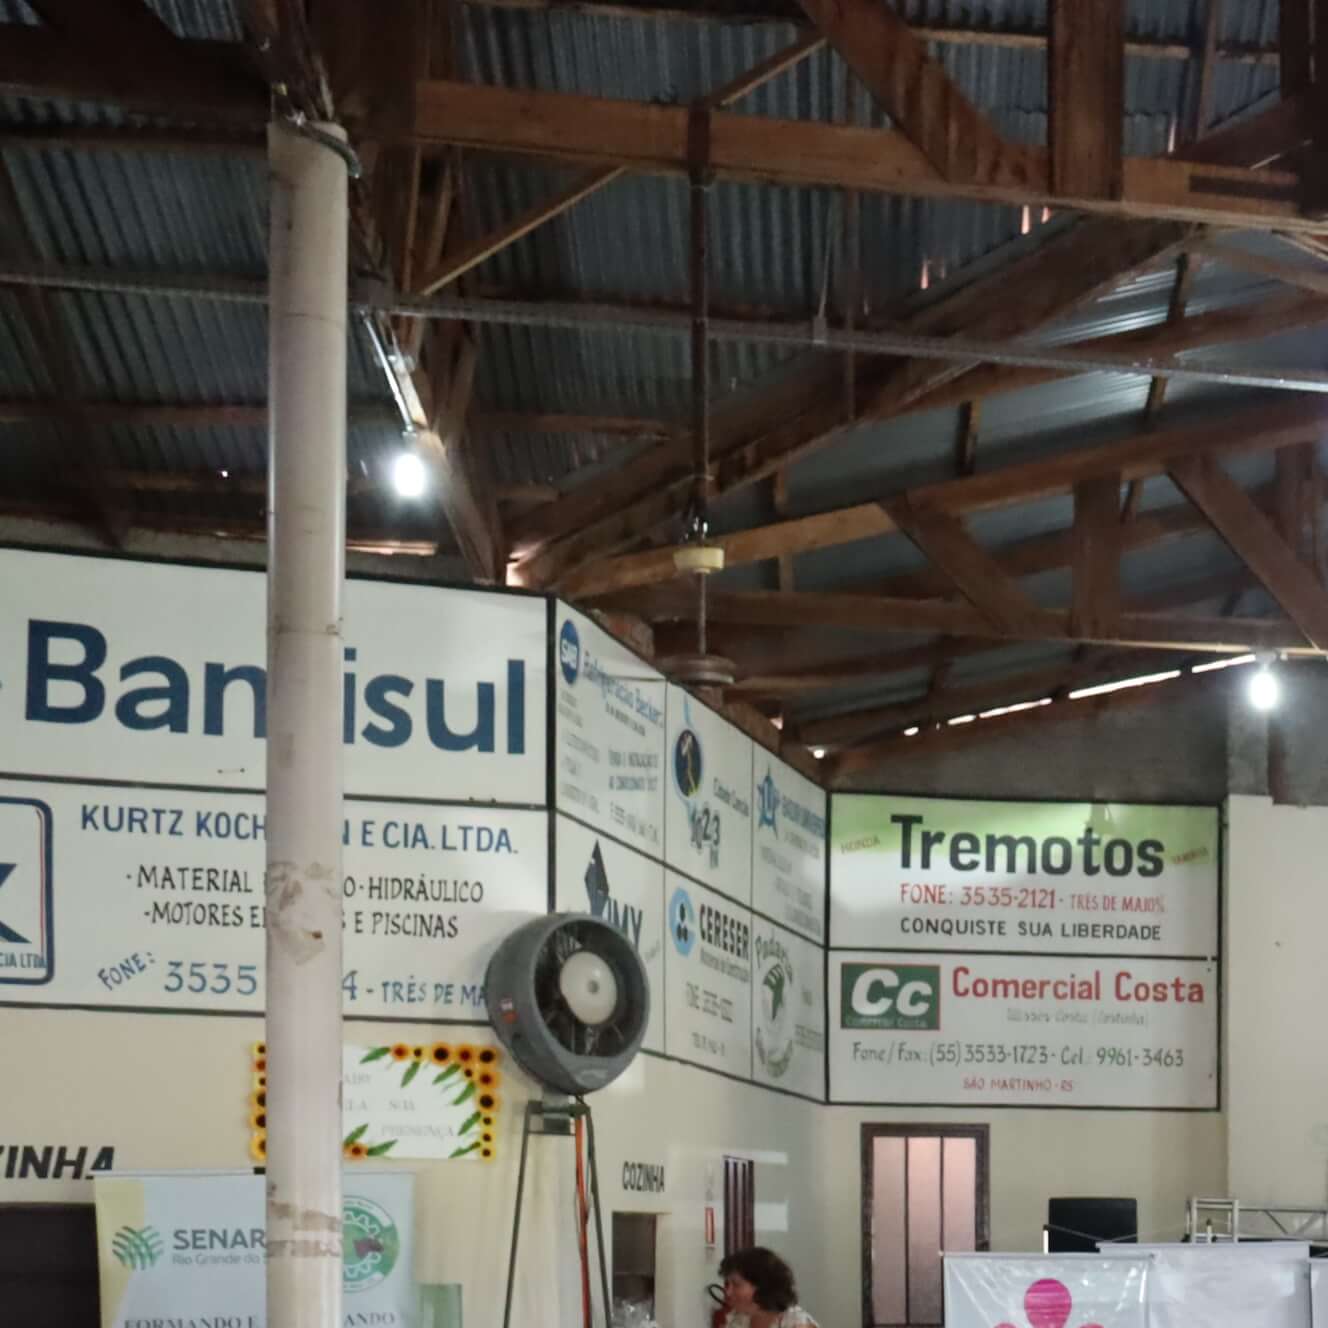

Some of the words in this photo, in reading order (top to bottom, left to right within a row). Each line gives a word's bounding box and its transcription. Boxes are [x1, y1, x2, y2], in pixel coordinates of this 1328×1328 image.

[25, 618, 526, 755] Banisul
[81, 804, 184, 836] KURTZ
[361, 820, 375, 847] E
[382, 821, 435, 850] CIA.
[441, 824, 518, 855] LTDA.
[891, 813, 1165, 878] Tremotos
[900, 883, 952, 906] FONE:
[959, 885, 1057, 910] 3535-2121
[1102, 894, 1120, 912] DE
[371, 911, 459, 939] PISCINAS
[700, 903, 750, 961] CERESER
[900, 916, 1008, 938] CONQUISTE
[1017, 920, 1054, 939] SUA
[1061, 922, 1162, 942] LIBERDADE
[97, 951, 156, 992] FONE:
[951, 965, 1102, 1002] Comercial
[1113, 970, 1206, 1004] Costa
[434, 983, 455, 1004] DE
[1095, 1046, 1186, 1069] 9961-3463
[989, 1078, 1052, 1093] MARTINHO
[0, 1145, 114, 1180] INHA
[622, 1160, 665, 1192] COZINHA
[173, 1228, 266, 1251] SENAR
[172, 1253, 193, 1265] Rio
[198, 1252, 241, 1266] Grande
